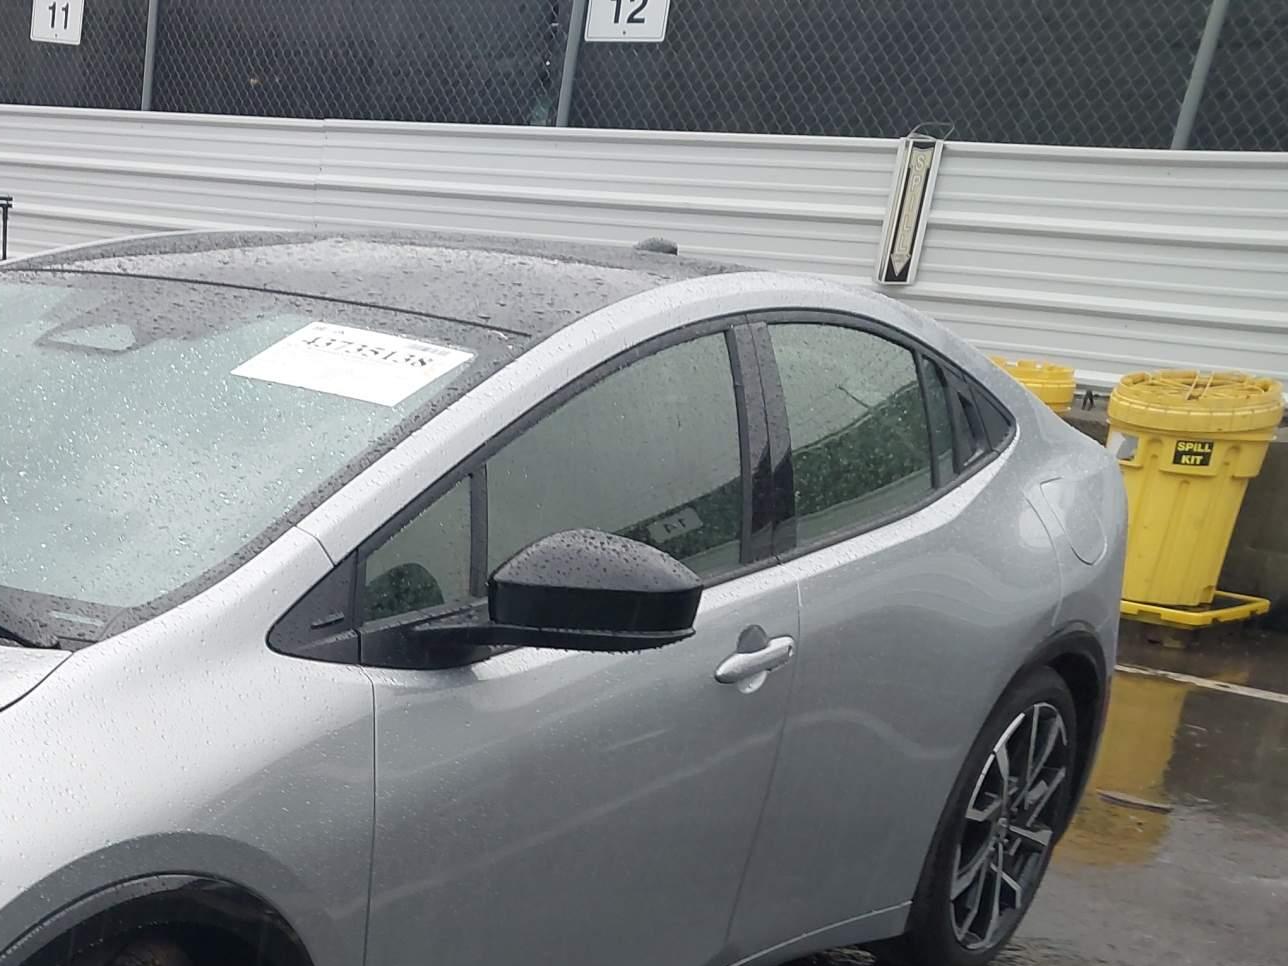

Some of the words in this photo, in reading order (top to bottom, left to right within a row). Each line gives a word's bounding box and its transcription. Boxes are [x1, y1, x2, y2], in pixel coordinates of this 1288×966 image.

[48, 2, 69, 30] 11
[612, 0, 649, 24] 12
[1177, 441, 1212, 453] SPILL
[1181, 454, 1204, 465] KIT
